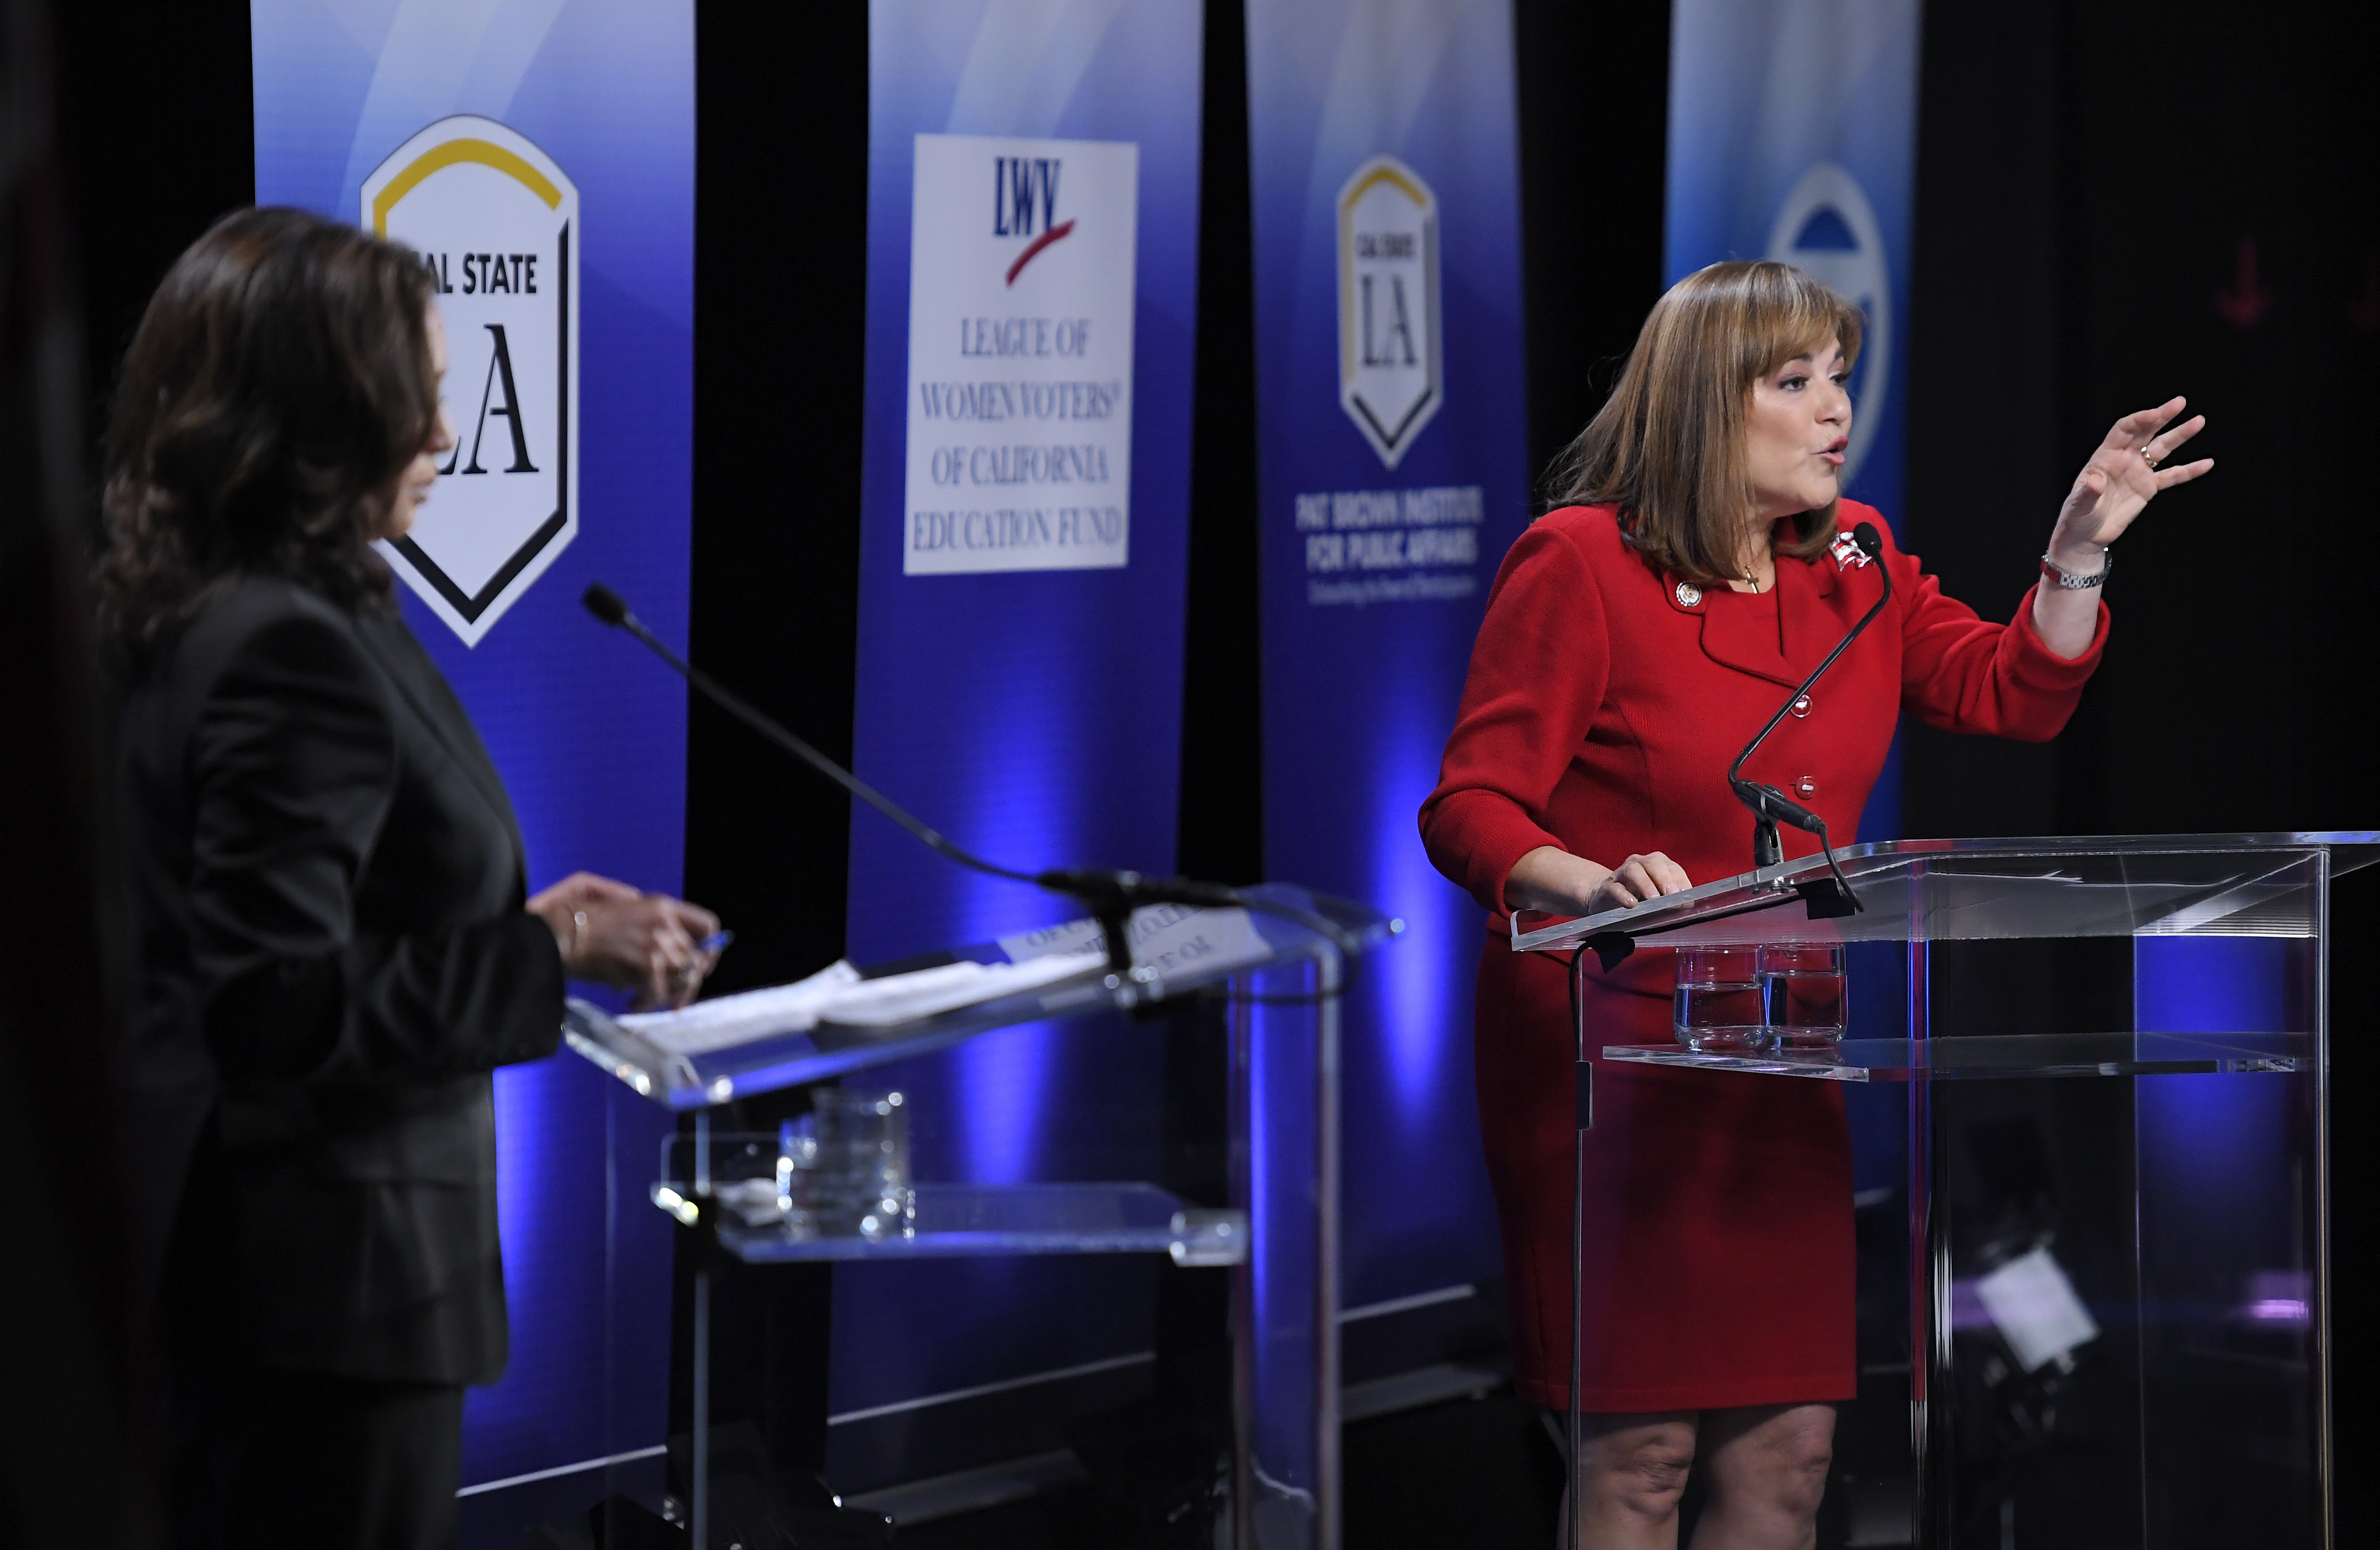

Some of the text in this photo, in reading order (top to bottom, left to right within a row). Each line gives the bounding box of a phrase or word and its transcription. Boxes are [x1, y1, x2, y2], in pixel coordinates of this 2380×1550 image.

[994, 157, 1061, 237] LWV
[425, 252, 537, 294] AL STATE
[960, 317, 1092, 356] LEAGUE OF
[436, 323, 540, 475] A
[921, 381, 1019, 421] WOMEN
[931, 444, 1110, 486] OF CALIFORNIA
[913, 505, 1123, 552] EDUCATION FUND
